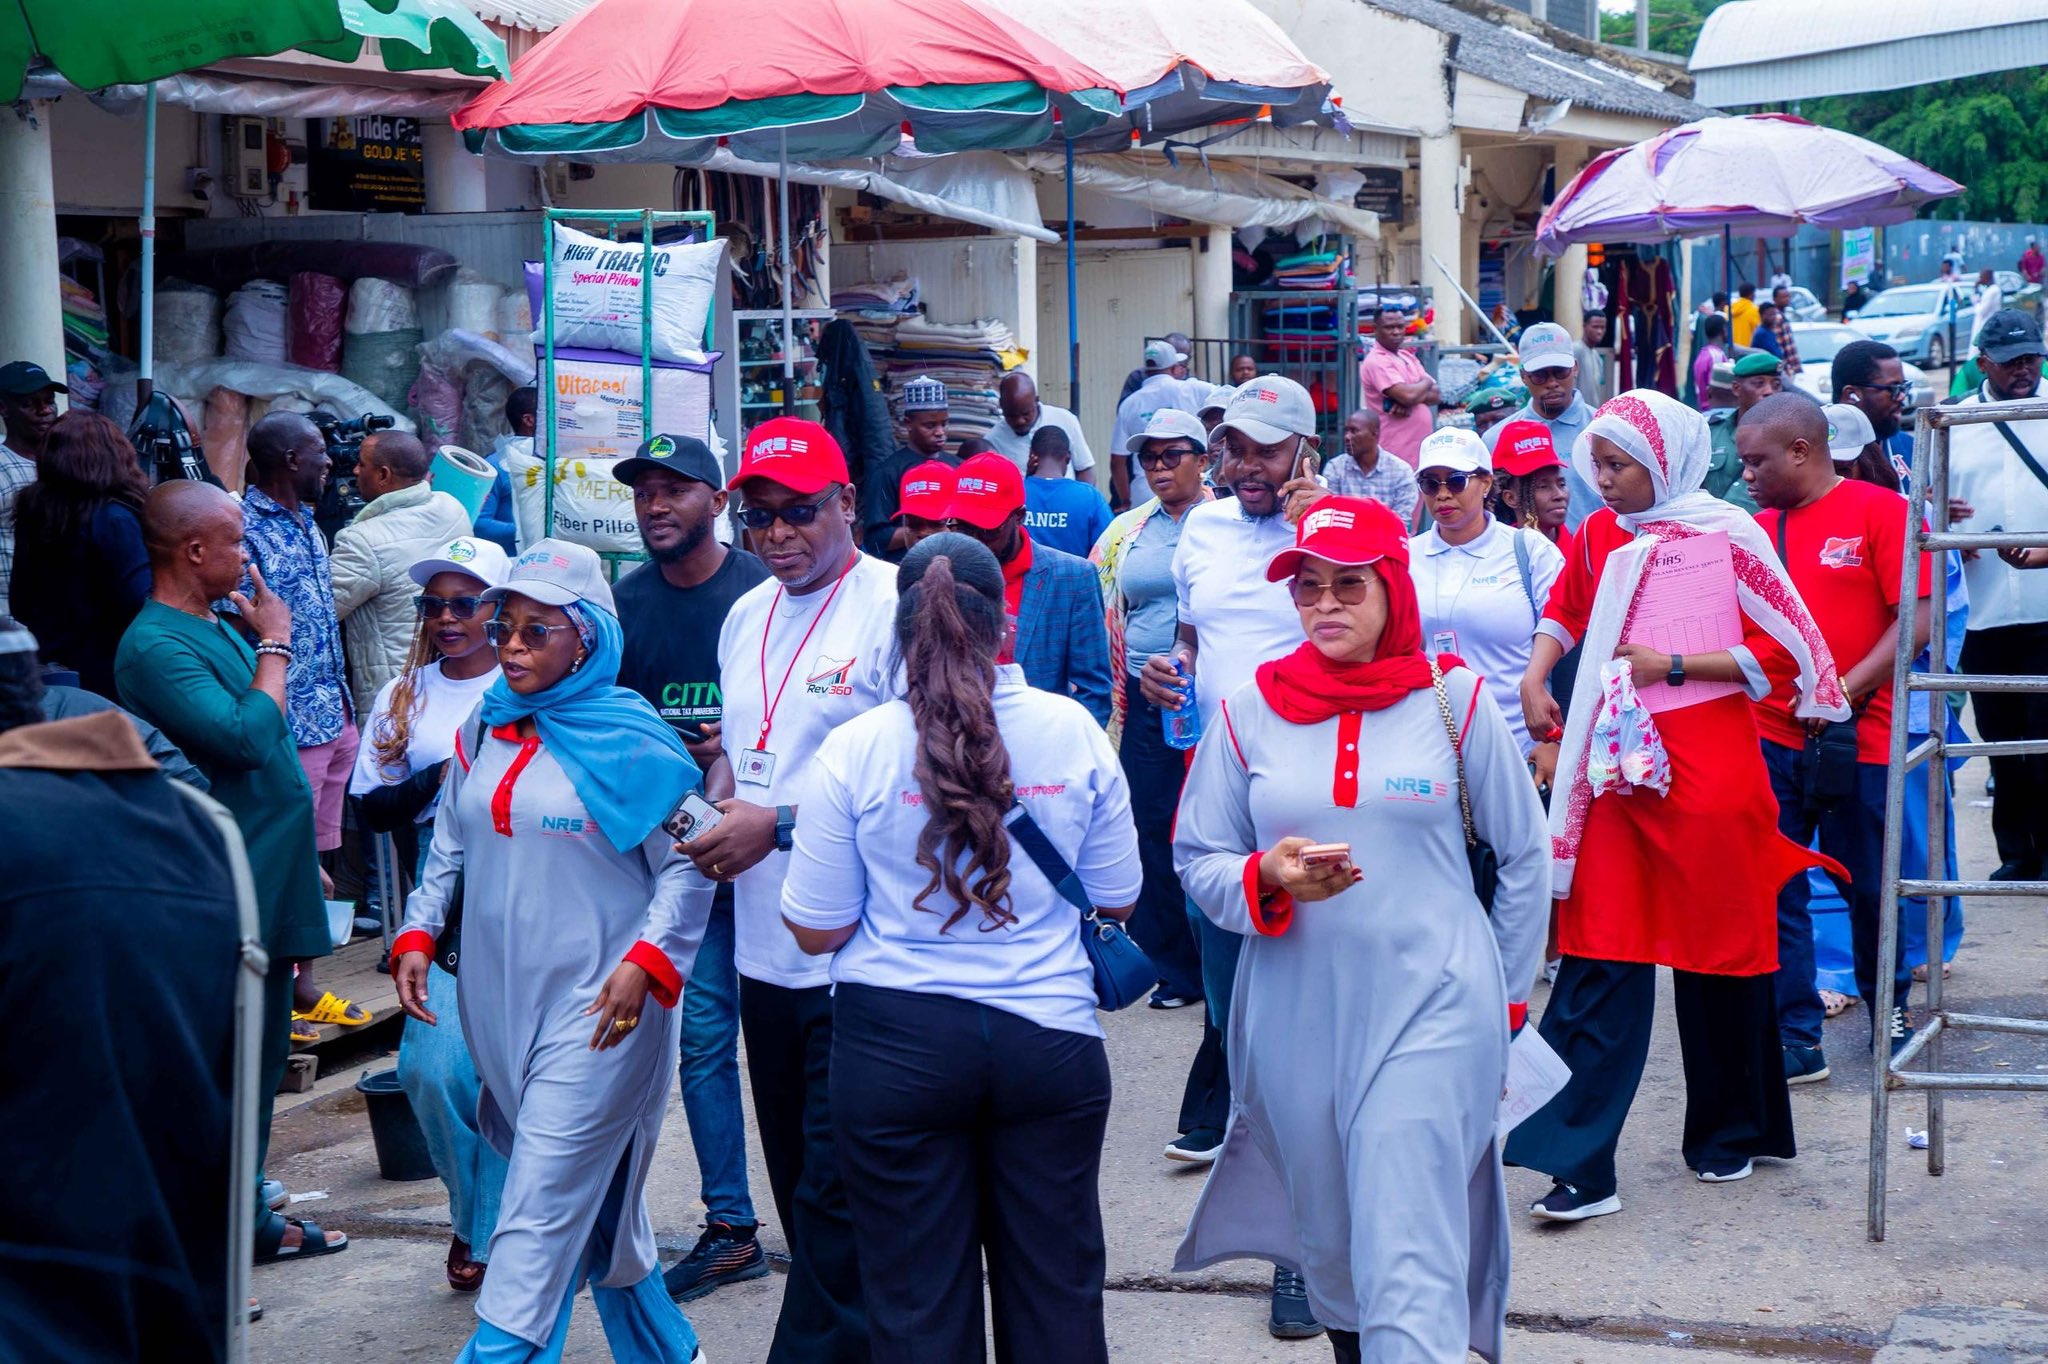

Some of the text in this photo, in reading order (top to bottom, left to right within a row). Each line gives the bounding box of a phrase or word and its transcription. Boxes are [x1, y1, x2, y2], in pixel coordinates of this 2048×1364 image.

[363, 144, 392, 159] GOLD
[561, 244, 598, 261] HIGH
[572, 271, 641, 287] Special Pillow
[752, 437, 788, 459] NRS
[1514, 437, 1542, 451] NRS
[906, 480, 927, 493] NRS
[958, 478, 983, 490] NRS
[554, 511, 639, 533] Fiber Pillo
[516, 552, 550, 567] NRS
[1655, 554, 1682, 568] FIRS
[681, 708, 693, 716] TAX
[1032, 784, 1066, 799] prosper
[1384, 778, 1432, 795] NRS
[542, 815, 584, 832] NRS
[685, 819, 704, 842] NRS
